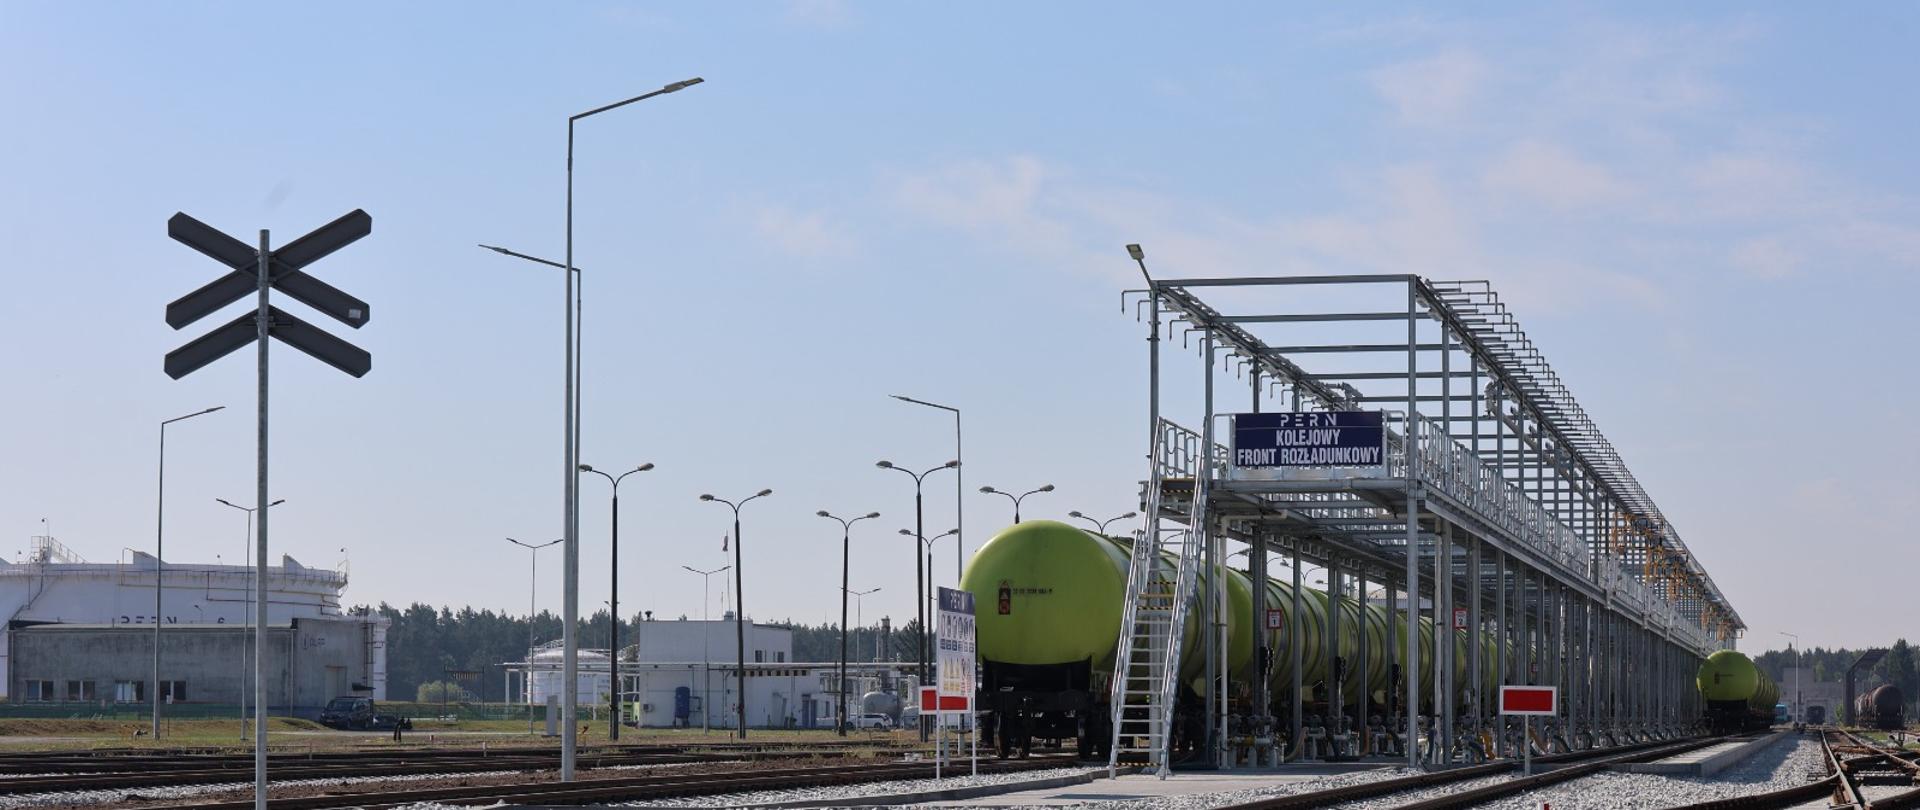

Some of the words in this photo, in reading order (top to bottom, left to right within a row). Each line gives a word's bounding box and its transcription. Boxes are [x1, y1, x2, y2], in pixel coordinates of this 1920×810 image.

[1280, 413, 1337, 427] PERN
[1275, 429, 1341, 447] KOLEJOWY
[1237, 448, 1277, 465] FRONT
[1281, 447, 1380, 464] ROZŁADUNKOWY
